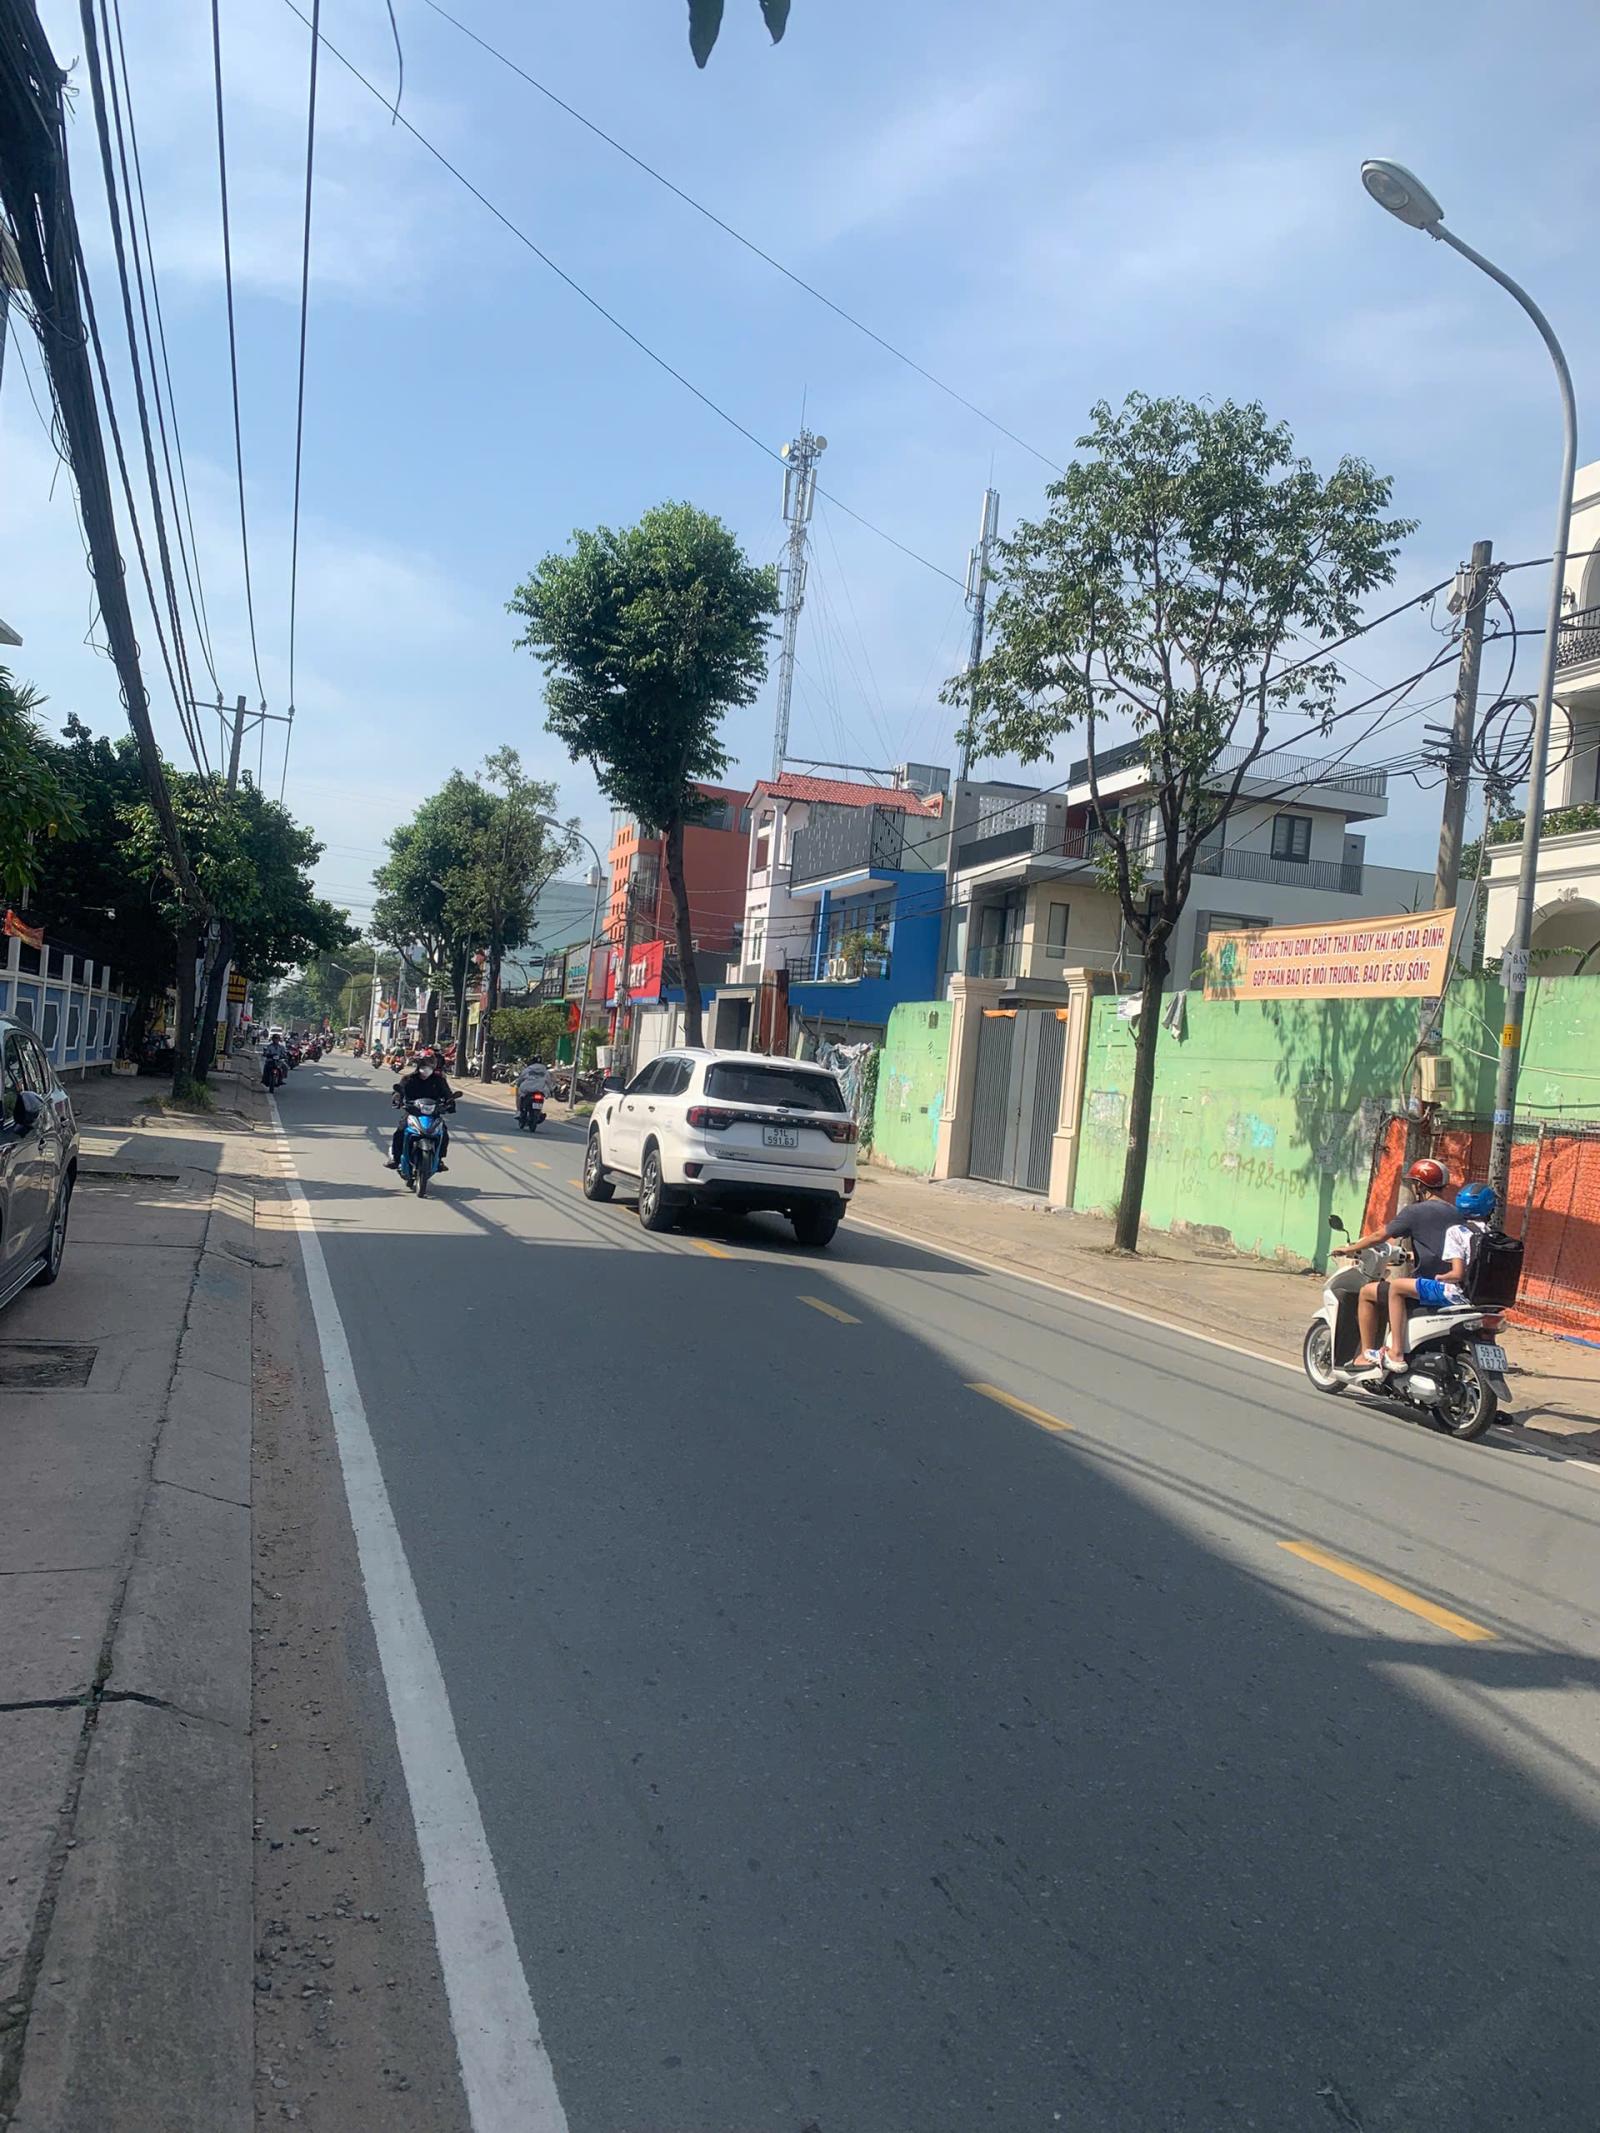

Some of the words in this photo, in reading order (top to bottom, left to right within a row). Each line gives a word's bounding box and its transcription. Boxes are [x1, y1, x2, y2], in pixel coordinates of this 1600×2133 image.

[1280, 941, 1294, 957] THU
[1295, 939, 1311, 957] GOM
[1352, 934, 1374, 952] NGUY
[1405, 929, 1420, 949] GIA
[773, 1128, 789, 1137] 51L
